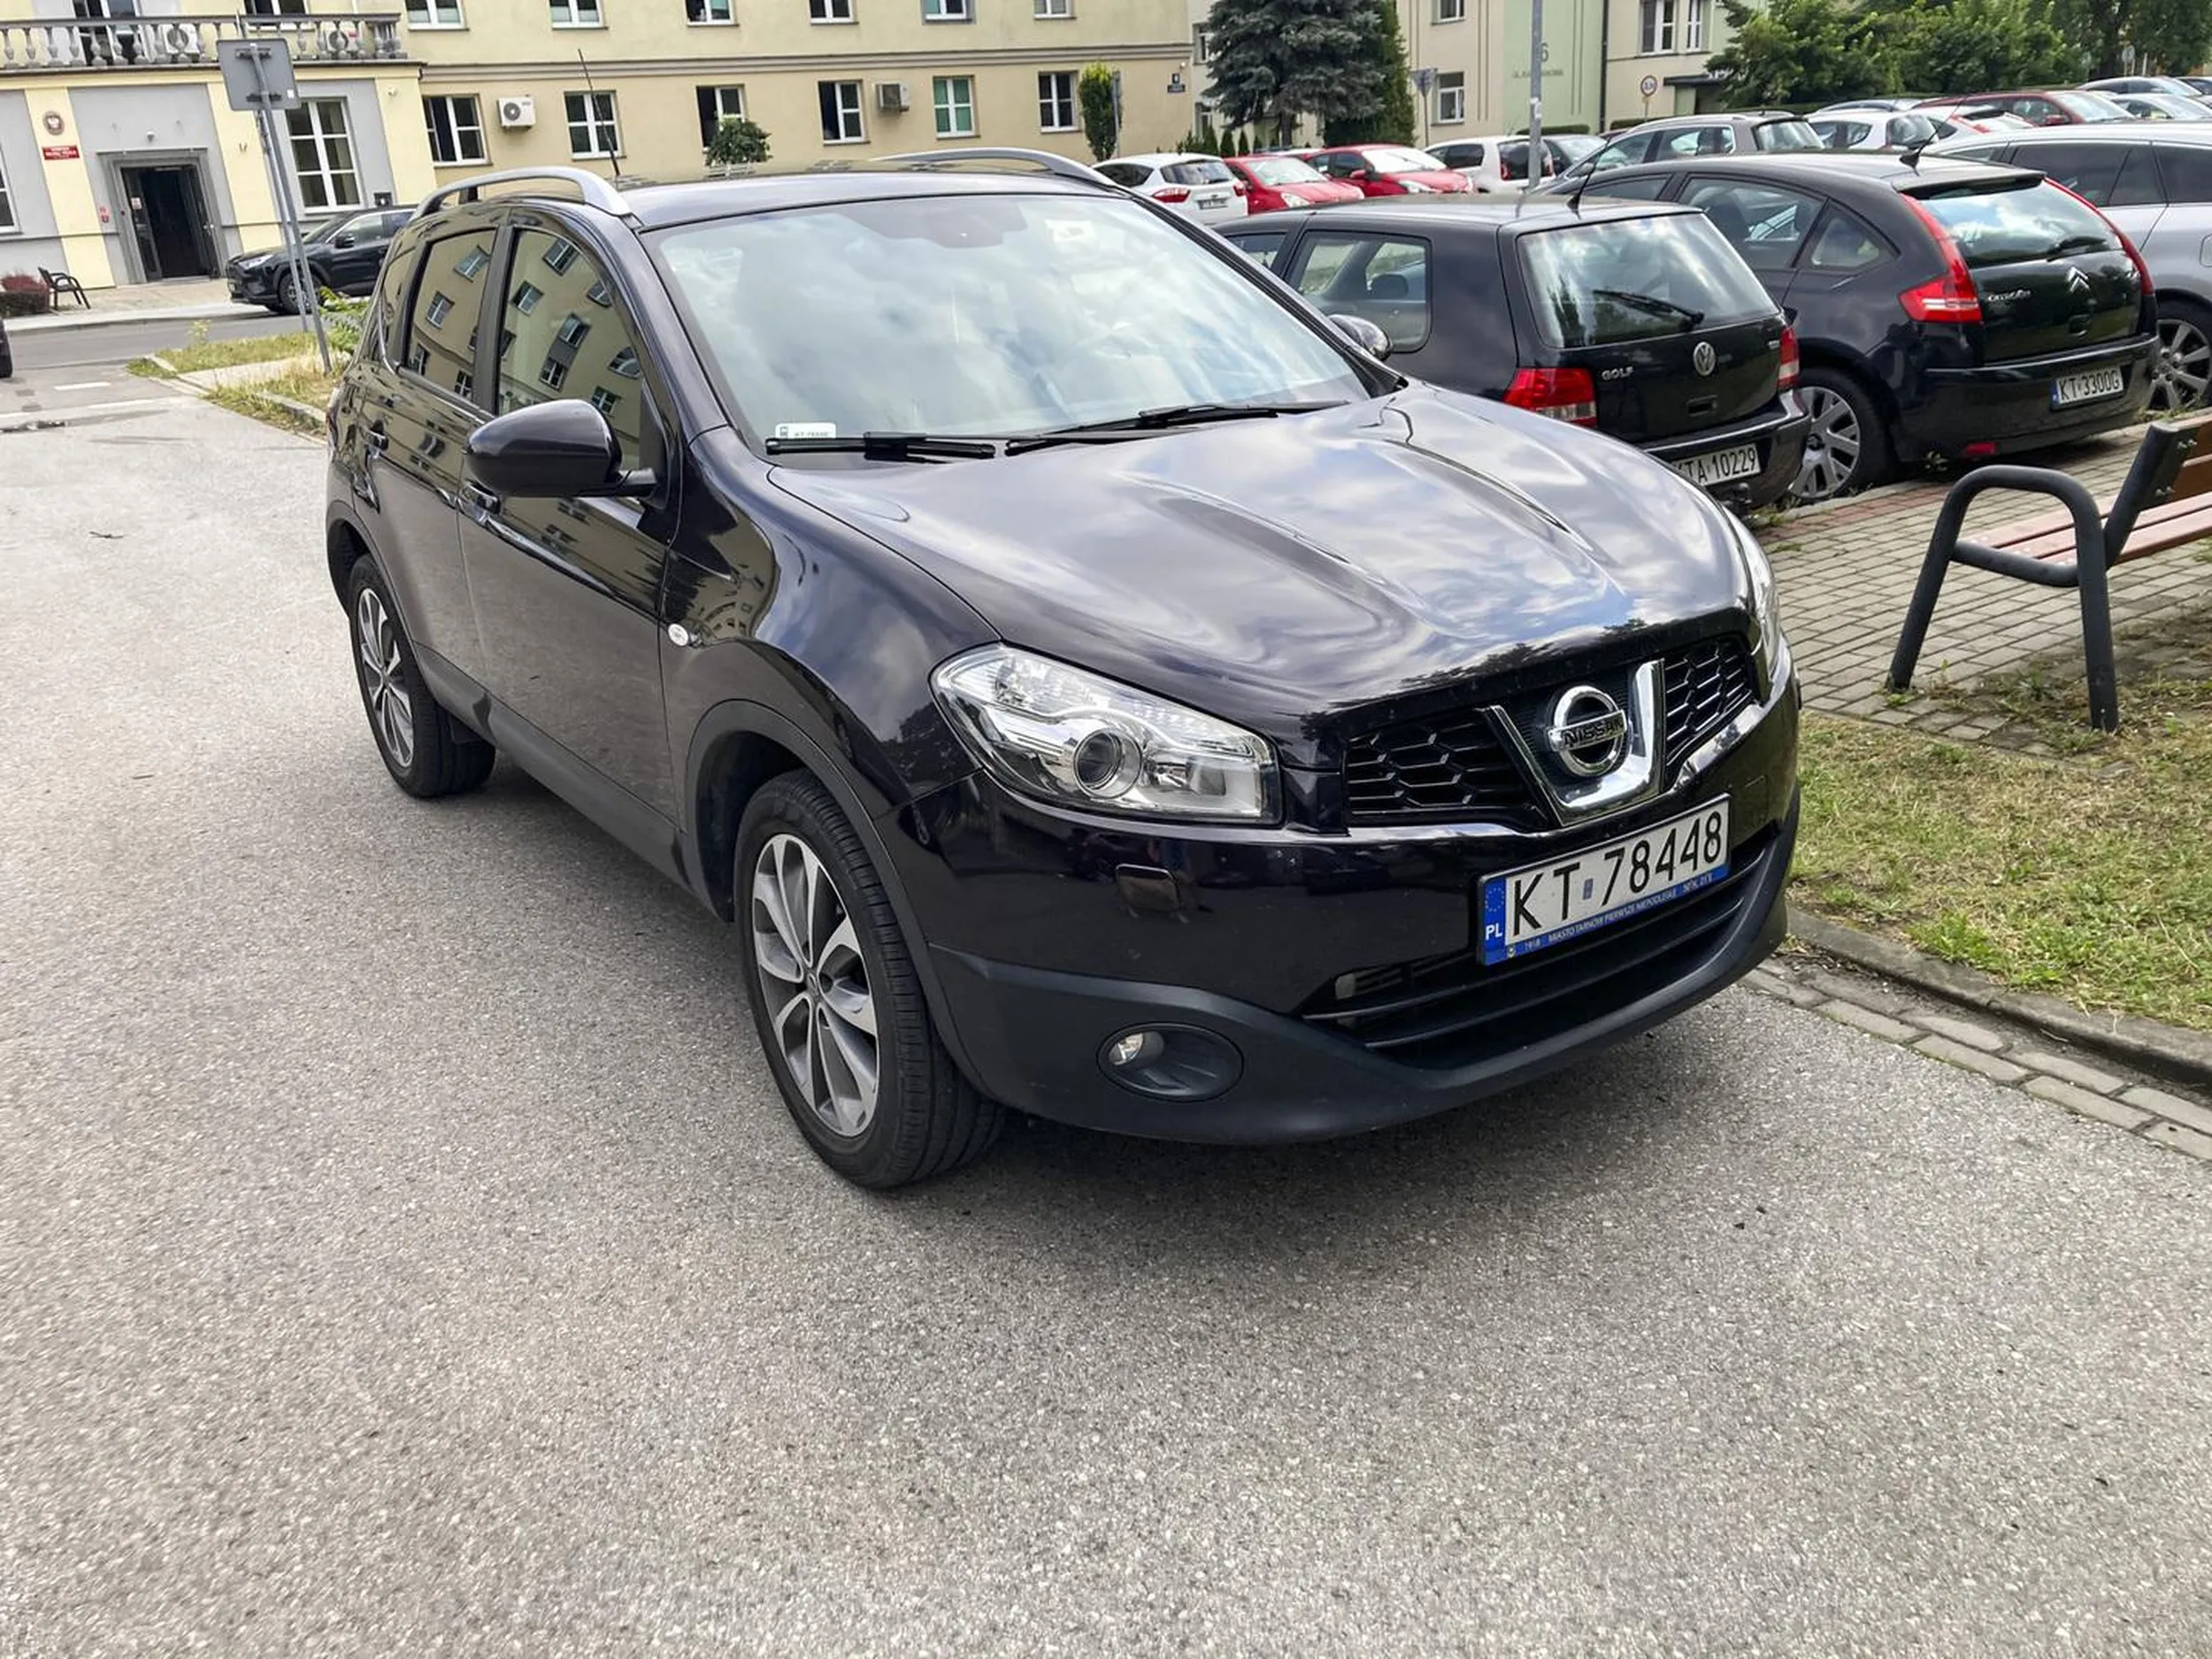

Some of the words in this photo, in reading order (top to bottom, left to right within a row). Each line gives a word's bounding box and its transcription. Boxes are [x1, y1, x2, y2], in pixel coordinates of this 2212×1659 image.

[1601, 366, 1634, 380] GOLF
[2060, 377, 2078, 401] KT
[2081, 369, 2120, 396] 3300G
[1711, 447, 1756, 478] 10229
[1563, 718, 1623, 748] NISSAN
[1513, 861, 1580, 937] KT
[1601, 810, 1722, 907] 78448
[1486, 922, 1503, 941] PL
